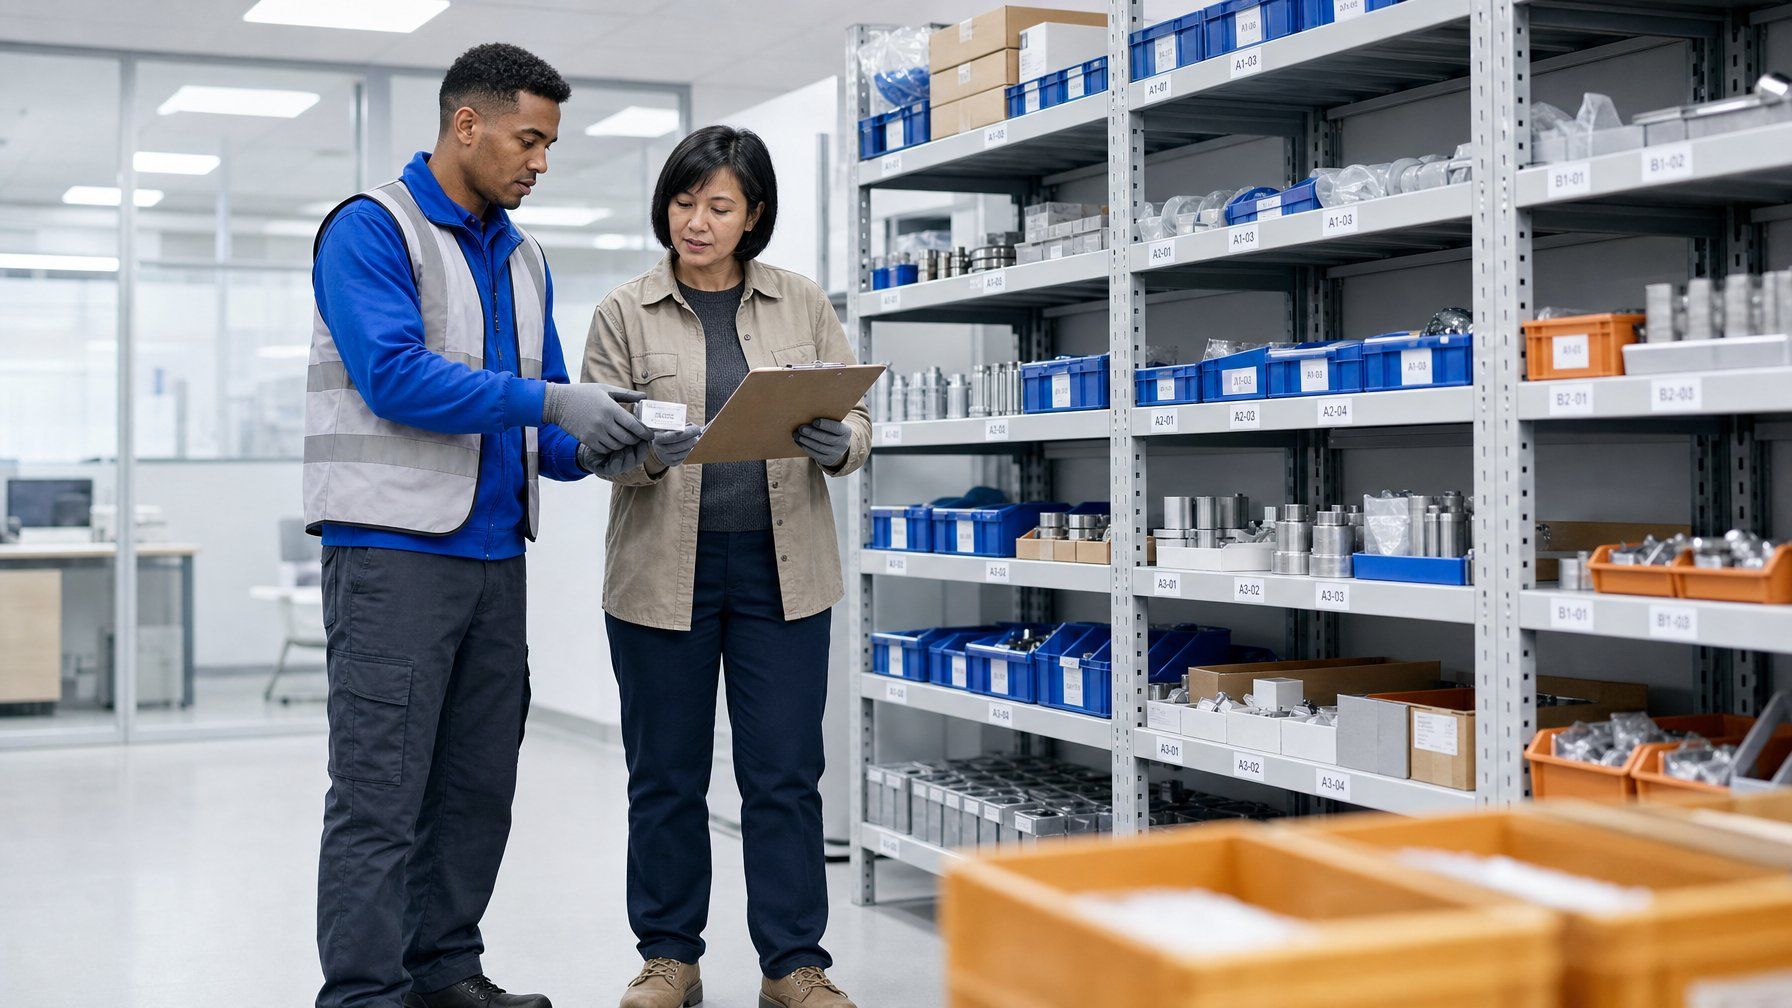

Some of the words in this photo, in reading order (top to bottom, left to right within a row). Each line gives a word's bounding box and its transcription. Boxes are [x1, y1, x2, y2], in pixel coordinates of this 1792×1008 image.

[1235, 55, 1257, 70] A1-03
[1149, 82, 1167, 95] A1-01
[1556, 172, 1584, 187] B1-01
[1328, 215, 1353, 228] A1-03
[1233, 231, 1254, 244] A1-03
[1153, 247, 1171, 259] A2-01
[1557, 393, 1587, 406] B2-01
[1234, 411, 1255, 421] A2-03
[1323, 406, 1347, 417] A2-04
[1155, 416, 1173, 426] A2-01
[1158, 579, 1177, 589] A3-01
[1239, 585, 1259, 595] A3-02
[1321, 590, 1344, 602] A3-03
[1559, 607, 1587, 620] B1-01
[1161, 744, 1179, 756] A3-01
[1238, 760, 1259, 773] A3-02
[1322, 777, 1344, 791] A3-04
